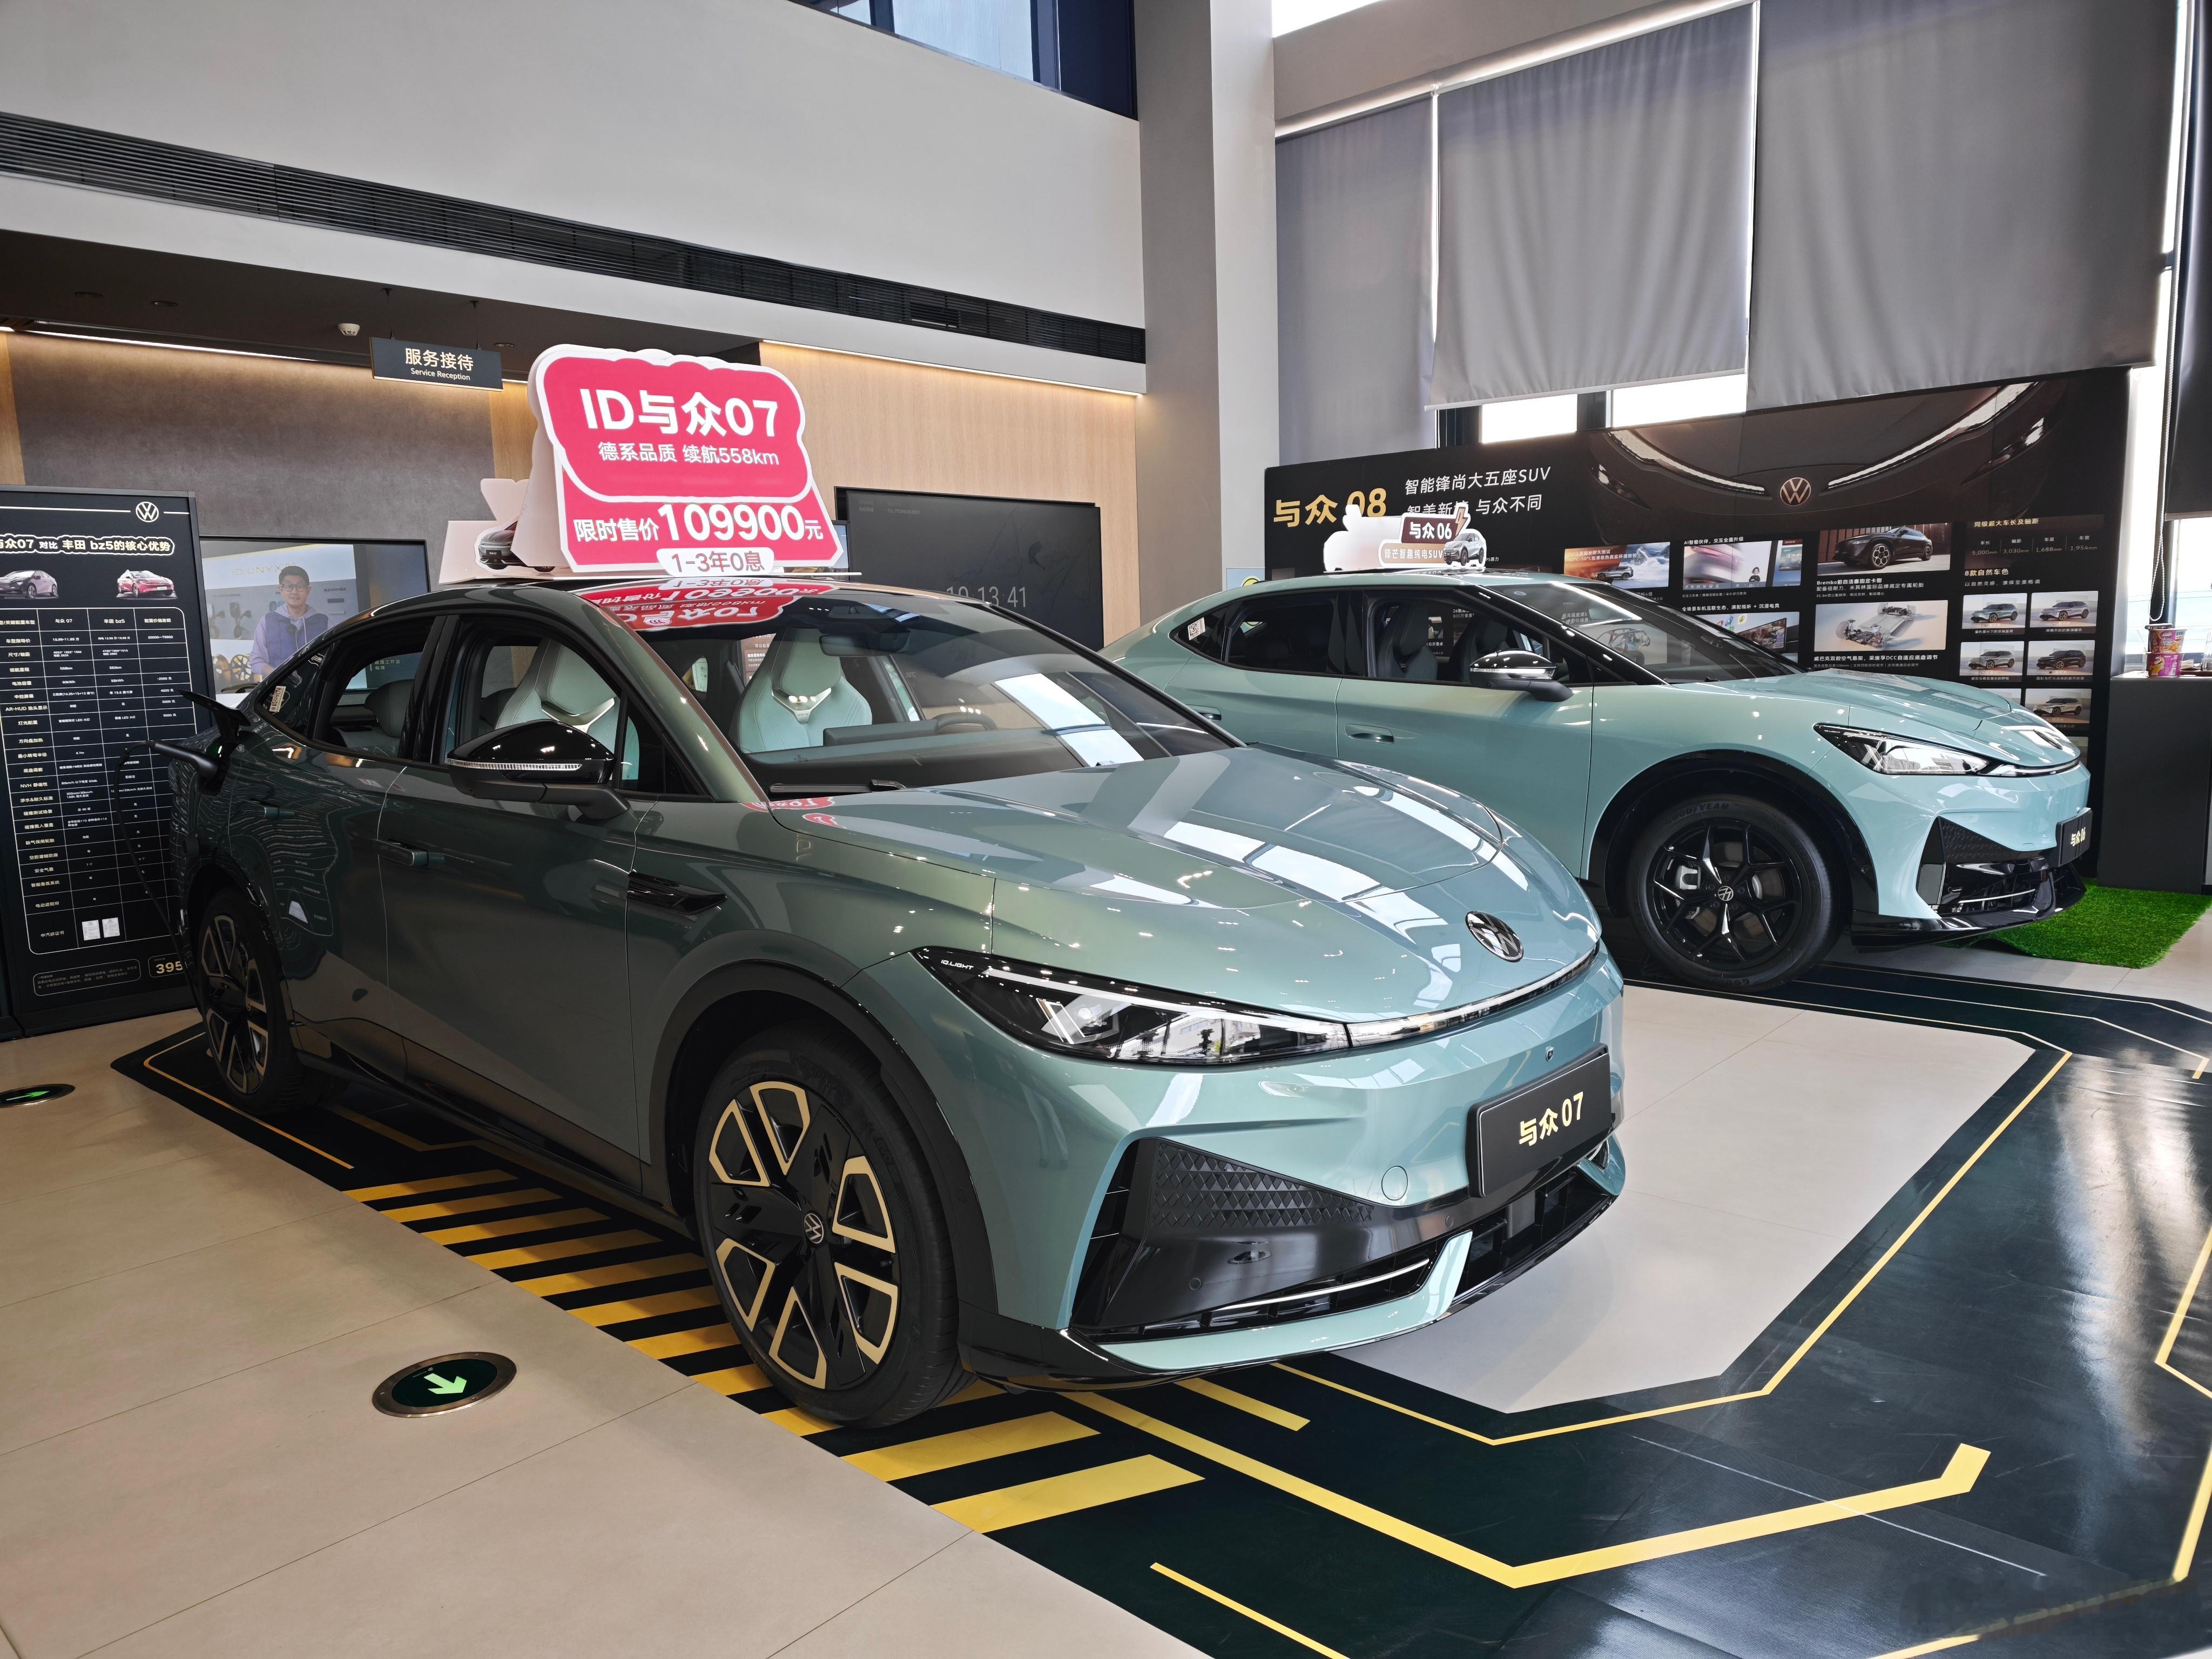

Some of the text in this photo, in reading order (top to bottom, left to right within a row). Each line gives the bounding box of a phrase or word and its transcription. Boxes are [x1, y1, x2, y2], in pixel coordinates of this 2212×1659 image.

[405, 348, 474, 372] 服务接待
[411, 368, 470, 381] Service Reception
[579, 387, 779, 437] ID与众07
[598, 441, 780, 466] 德系品质 续航558km
[1405, 466, 1552, 495] 智能锋尚大五座SUV
[1273, 499, 1338, 528] 与众
[1475, 494, 1542, 515] 与众不同
[1409, 521, 1453, 540] 与众 06
[1974, 518, 2039, 528] 同级超大车长及轴距
[39, 541, 58, 550] 对比
[62, 540, 86, 550] 丰田
[90, 540, 171, 552] bz5的核心优势
[1384, 548, 1444, 560] 锋芒智趣纯电SUV
[670, 552, 766, 573] 1-3年0息
[1964, 568, 2009, 576] 8款自然车色
[941, 959, 974, 970] IQ.LIGHT
[1519, 1091, 1583, 1147] 与众 07
